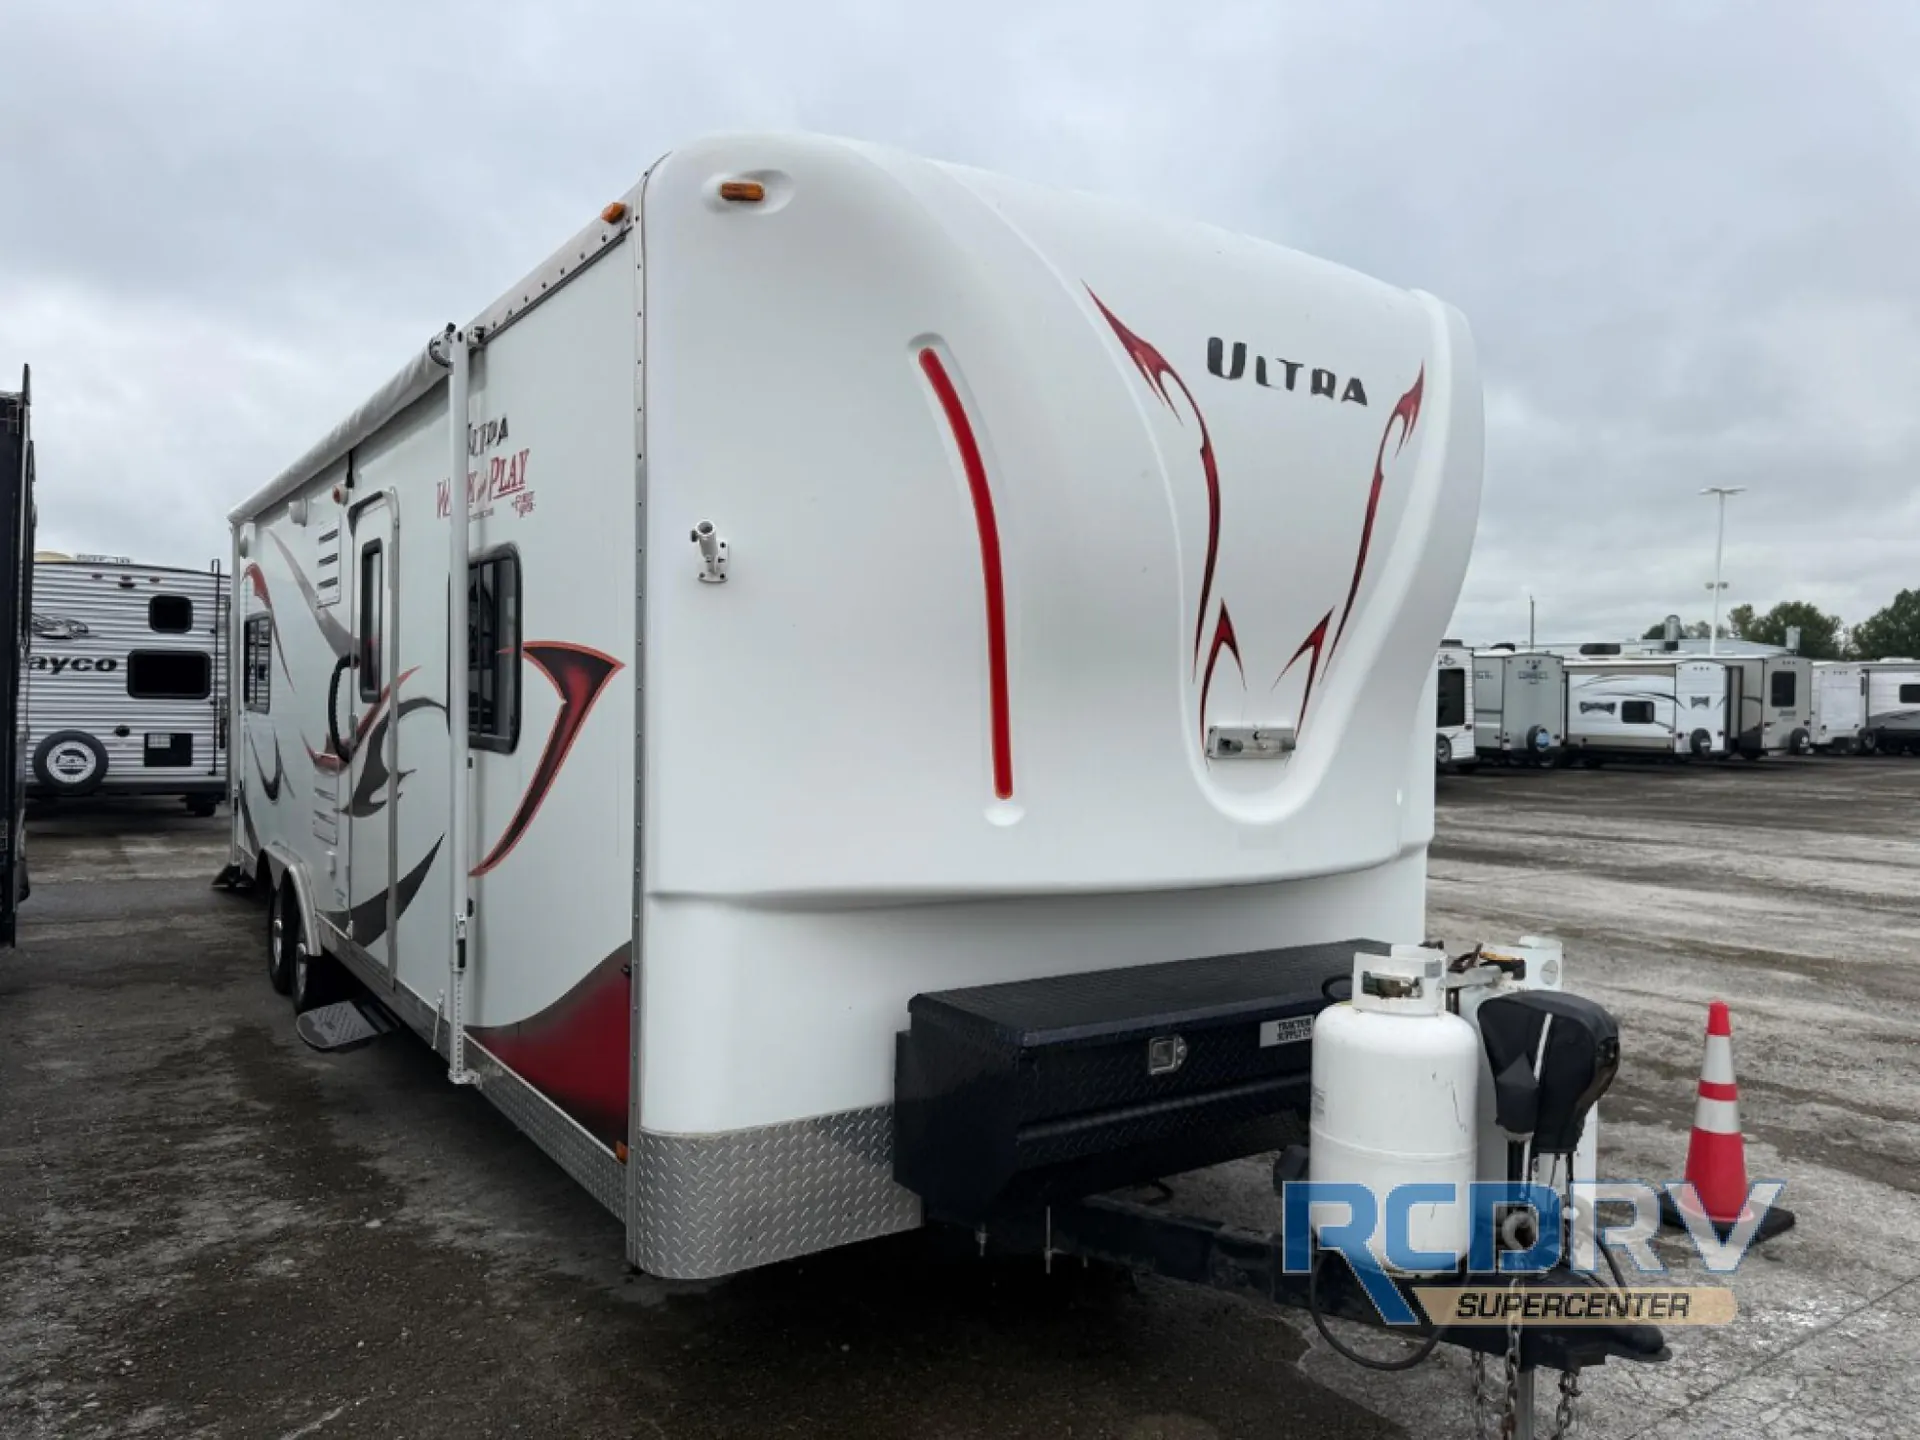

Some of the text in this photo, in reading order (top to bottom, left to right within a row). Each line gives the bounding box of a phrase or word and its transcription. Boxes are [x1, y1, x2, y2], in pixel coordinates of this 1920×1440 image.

[1207, 336, 1368, 407] ULTRA
[468, 416, 509, 456] LTRA
[488, 448, 530, 501] PLAY
[29, 656, 117, 675] ayco
